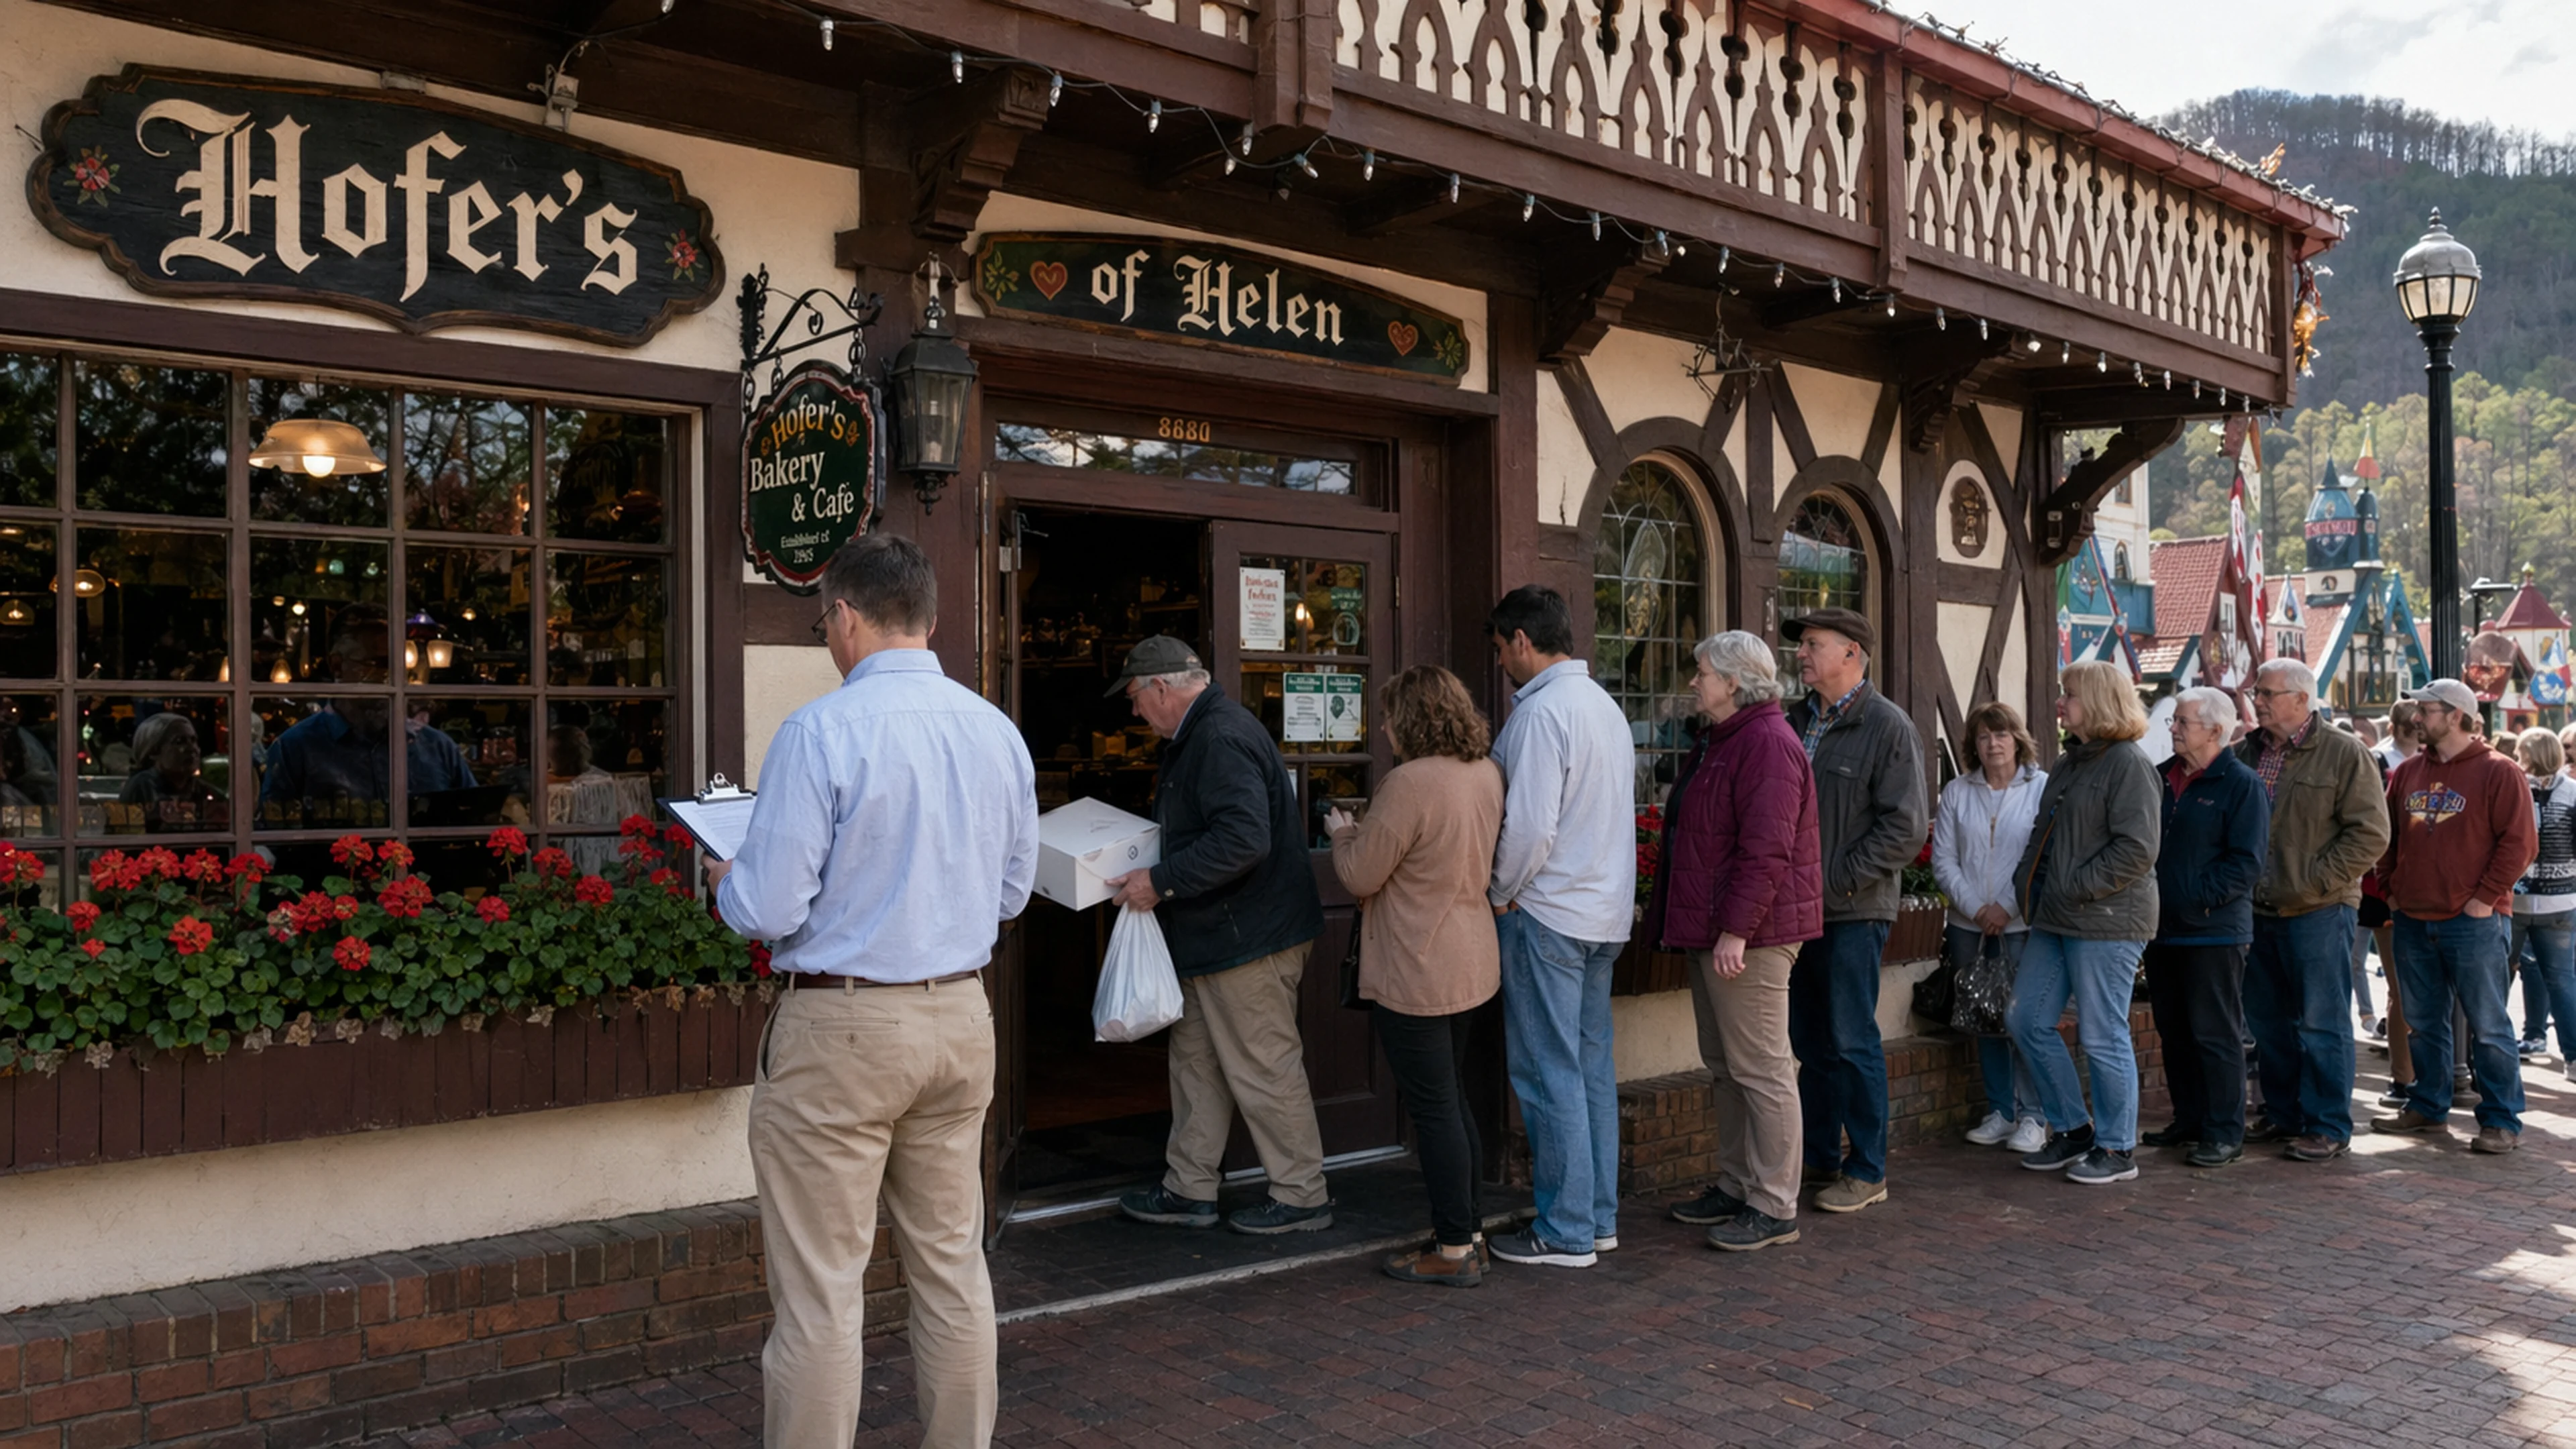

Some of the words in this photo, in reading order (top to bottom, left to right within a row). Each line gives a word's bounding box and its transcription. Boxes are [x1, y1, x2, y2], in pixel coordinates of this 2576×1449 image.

[136, 98, 638, 303] Hofer's
[1091, 250, 1150, 323] of
[1173, 255, 1345, 346] Helen
[770, 393, 846, 450] Hofer's
[749, 451, 826, 492] Bakery
[791, 492, 806, 523] &
